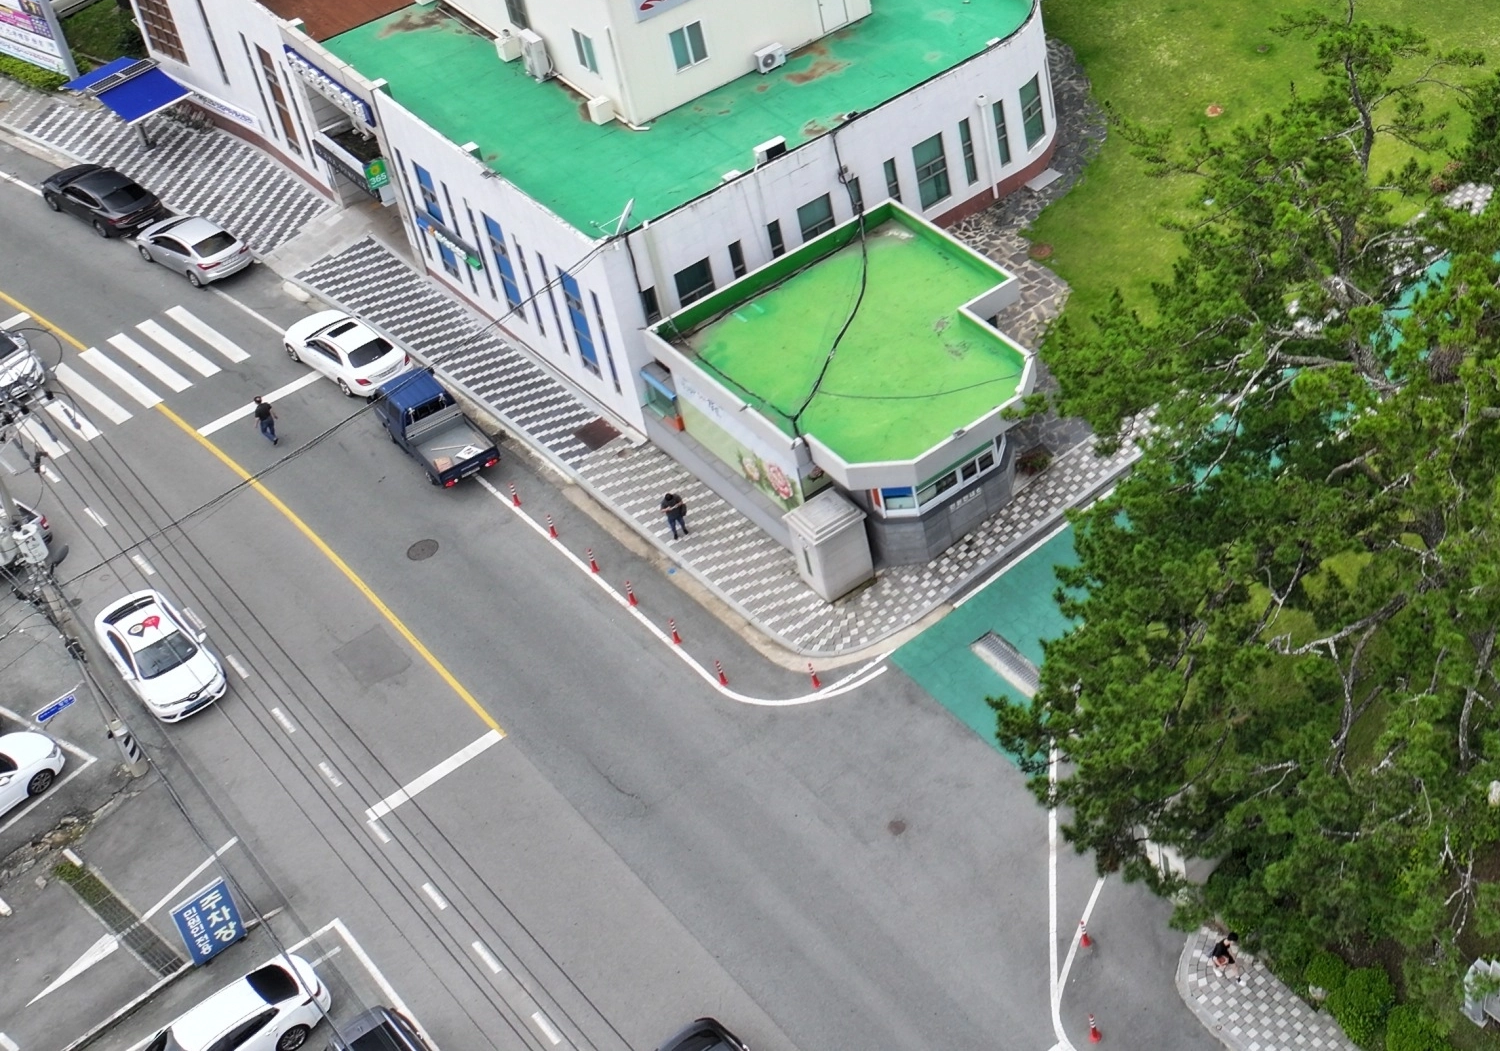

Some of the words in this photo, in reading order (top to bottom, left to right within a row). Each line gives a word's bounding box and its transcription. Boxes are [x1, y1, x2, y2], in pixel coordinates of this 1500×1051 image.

[369, 172, 387, 185] 365
[183, 906, 206, 938] 민원인
[195, 934, 212, 955] 전용
[199, 890, 237, 942] 주차장
